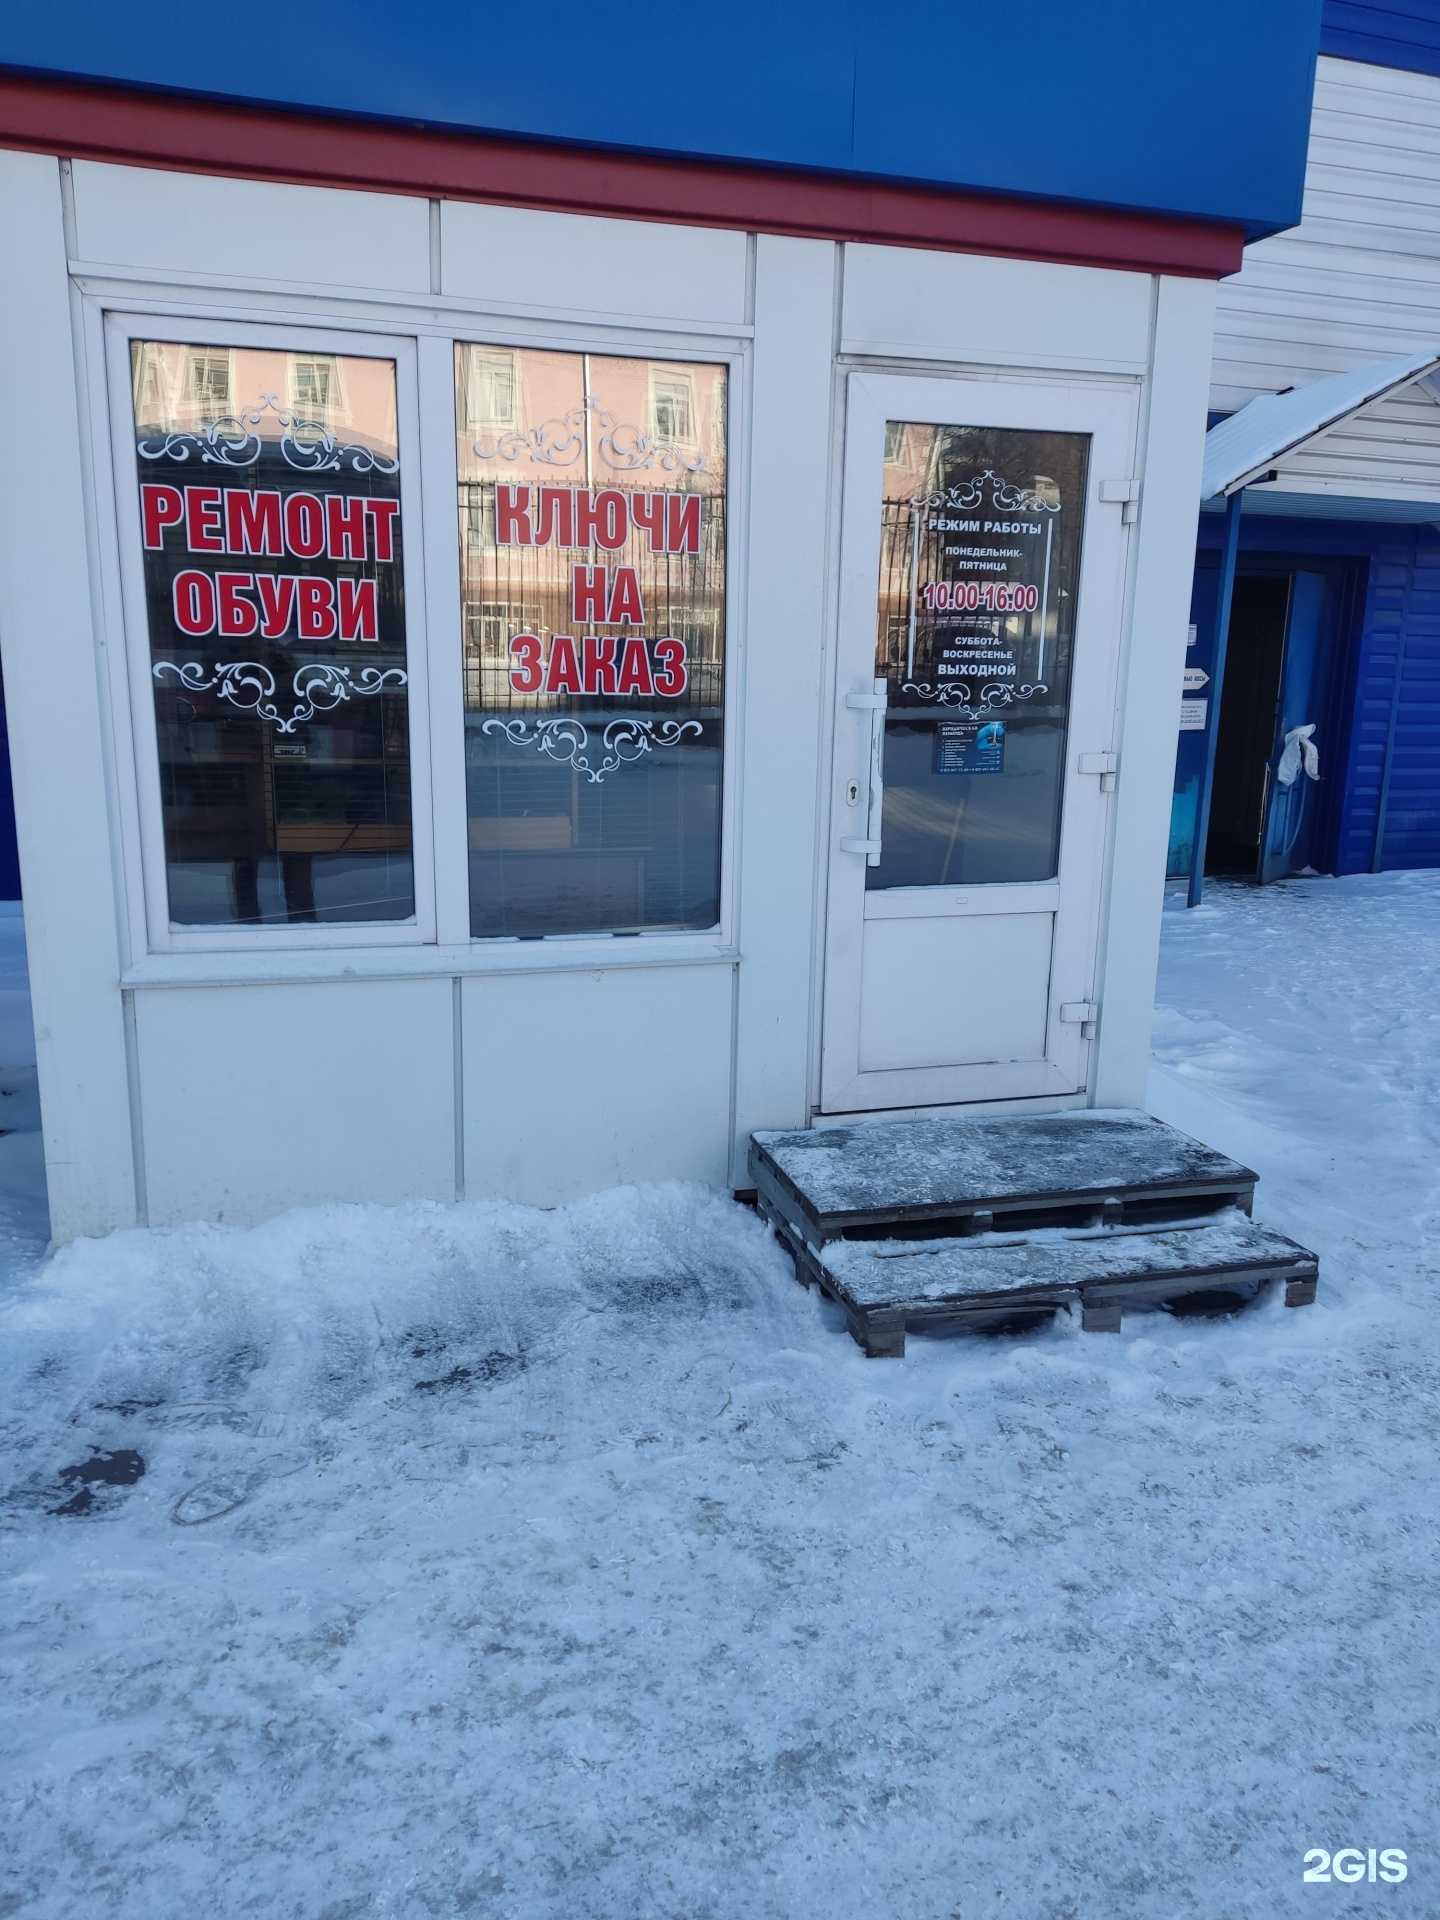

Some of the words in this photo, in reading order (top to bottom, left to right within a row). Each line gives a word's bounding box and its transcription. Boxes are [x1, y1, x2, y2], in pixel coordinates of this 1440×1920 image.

[140, 483, 399, 562] РЕМОНТ
[495, 483, 701, 554] КЛЮЧИ
[928, 518, 980, 533] РЕЖИМ
[984, 521, 1042, 535] РАБОТЫ
[945, 546, 1023, 558] ПОНЕДЕЛЬНИК-
[959, 560, 1008, 572] ПЯТНИЦА
[572, 563, 645, 626] НА
[173, 569, 379, 642] ОБУВИ
[954, 636, 1003, 646] СУББОТА-
[942, 649, 1014, 659] ВОСКРЕСЕНЬЕ
[509, 633, 688, 697] ЗАКАЗ
[937, 662, 1017, 678] ВЫХОДНОЙ
